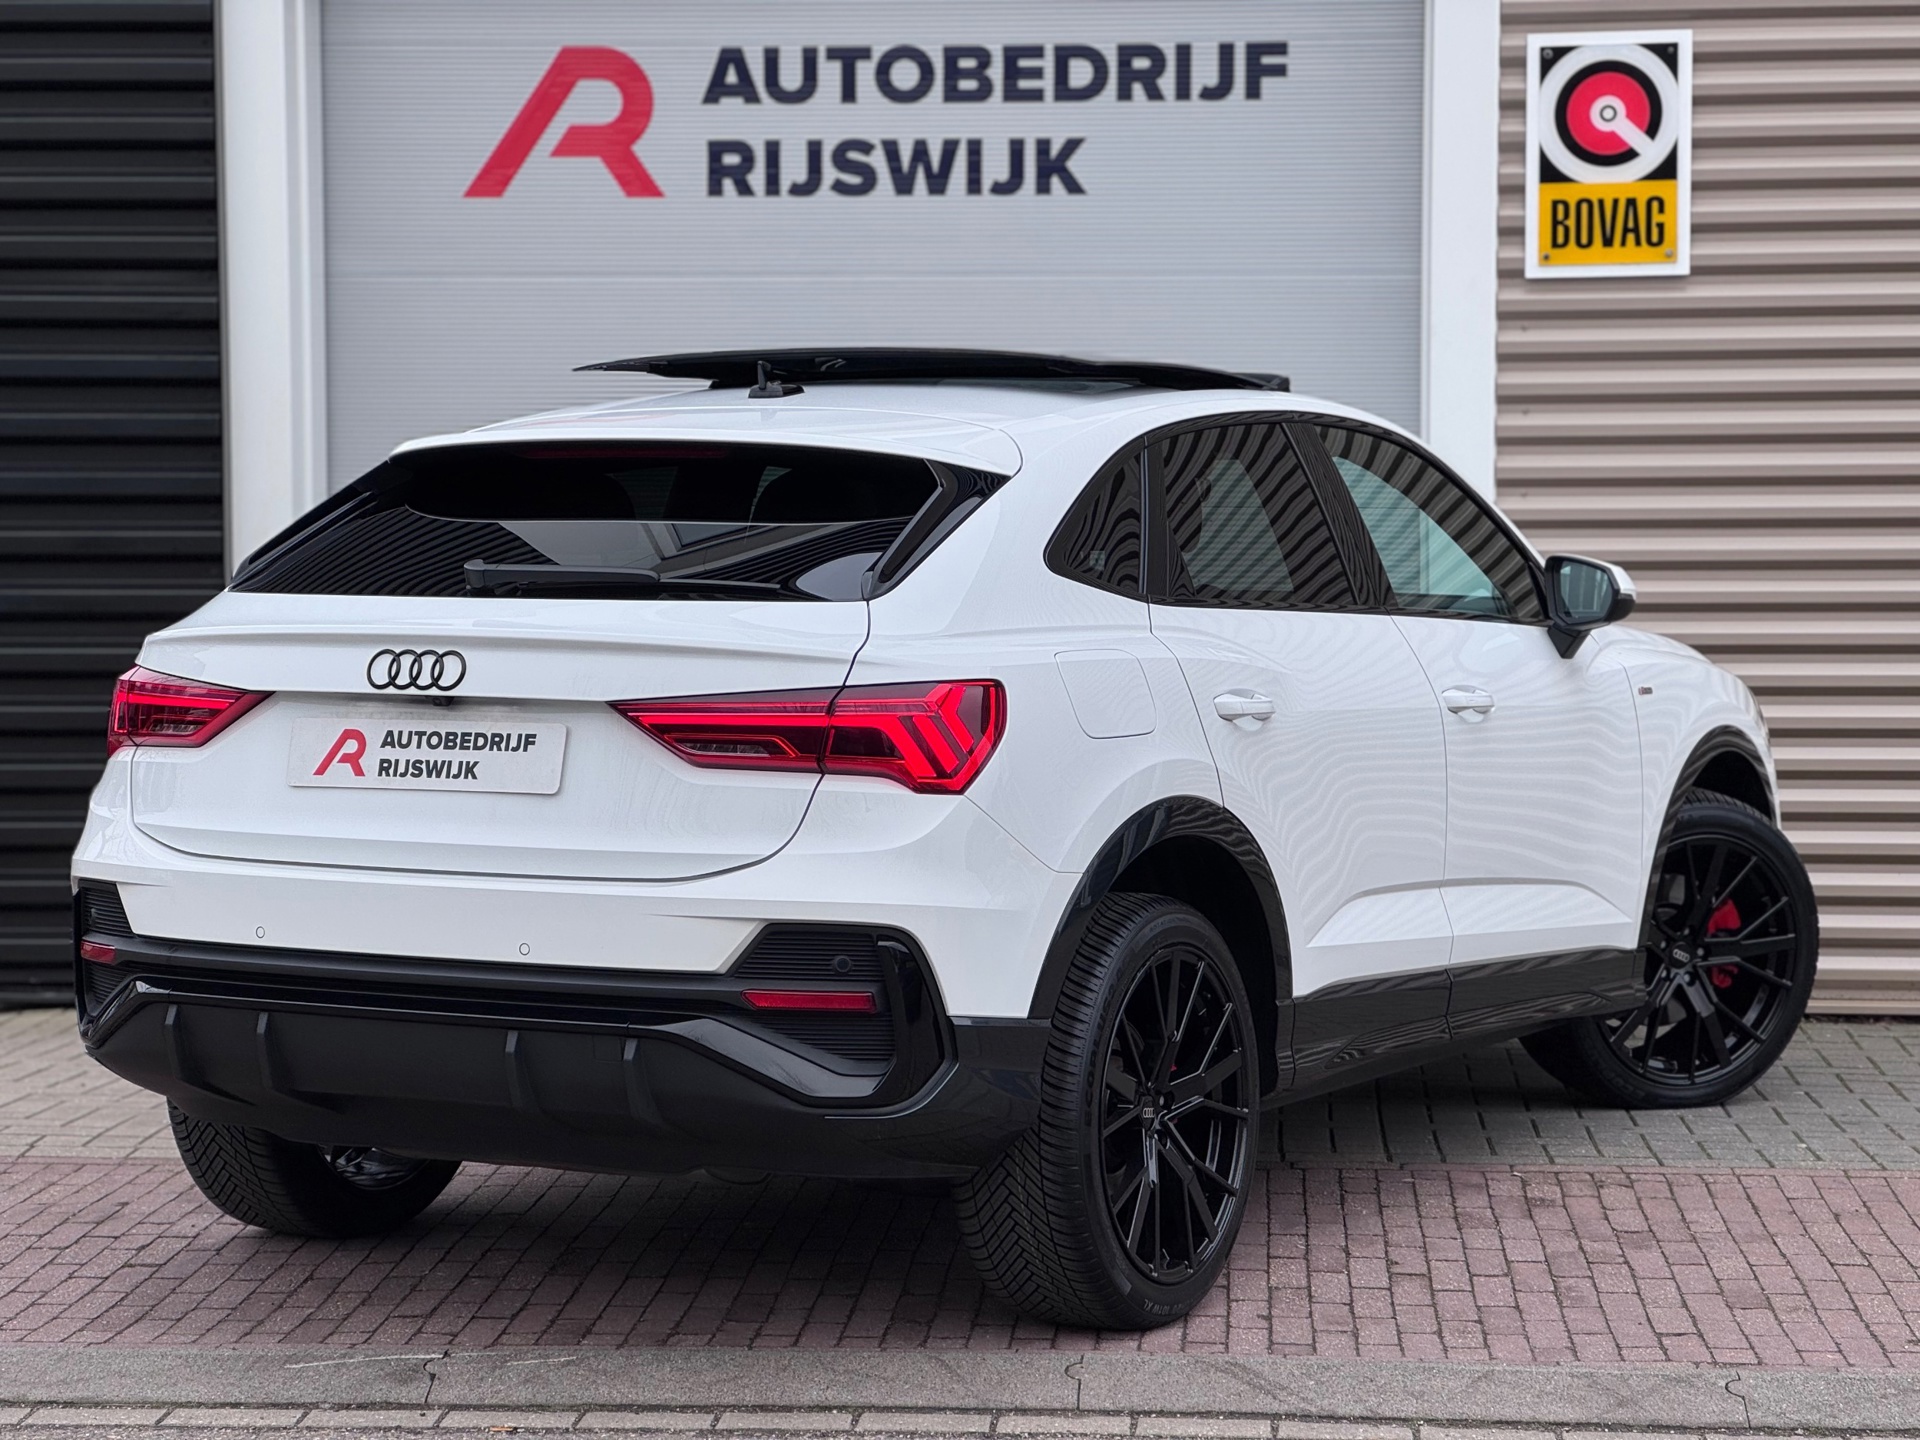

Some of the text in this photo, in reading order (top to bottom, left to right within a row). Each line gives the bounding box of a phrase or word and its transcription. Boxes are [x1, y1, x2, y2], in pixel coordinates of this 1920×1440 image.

[701, 41, 1288, 105] AUTOBEDRIJF
[706, 136, 1088, 197] RIJSWIJK
[1551, 195, 1665, 249] BOVAG
[380, 730, 537, 752] AUTOBEDRIJF
[377, 758, 479, 780] RIJSWIJK
[1143, 1298, 1154, 1312] XL
